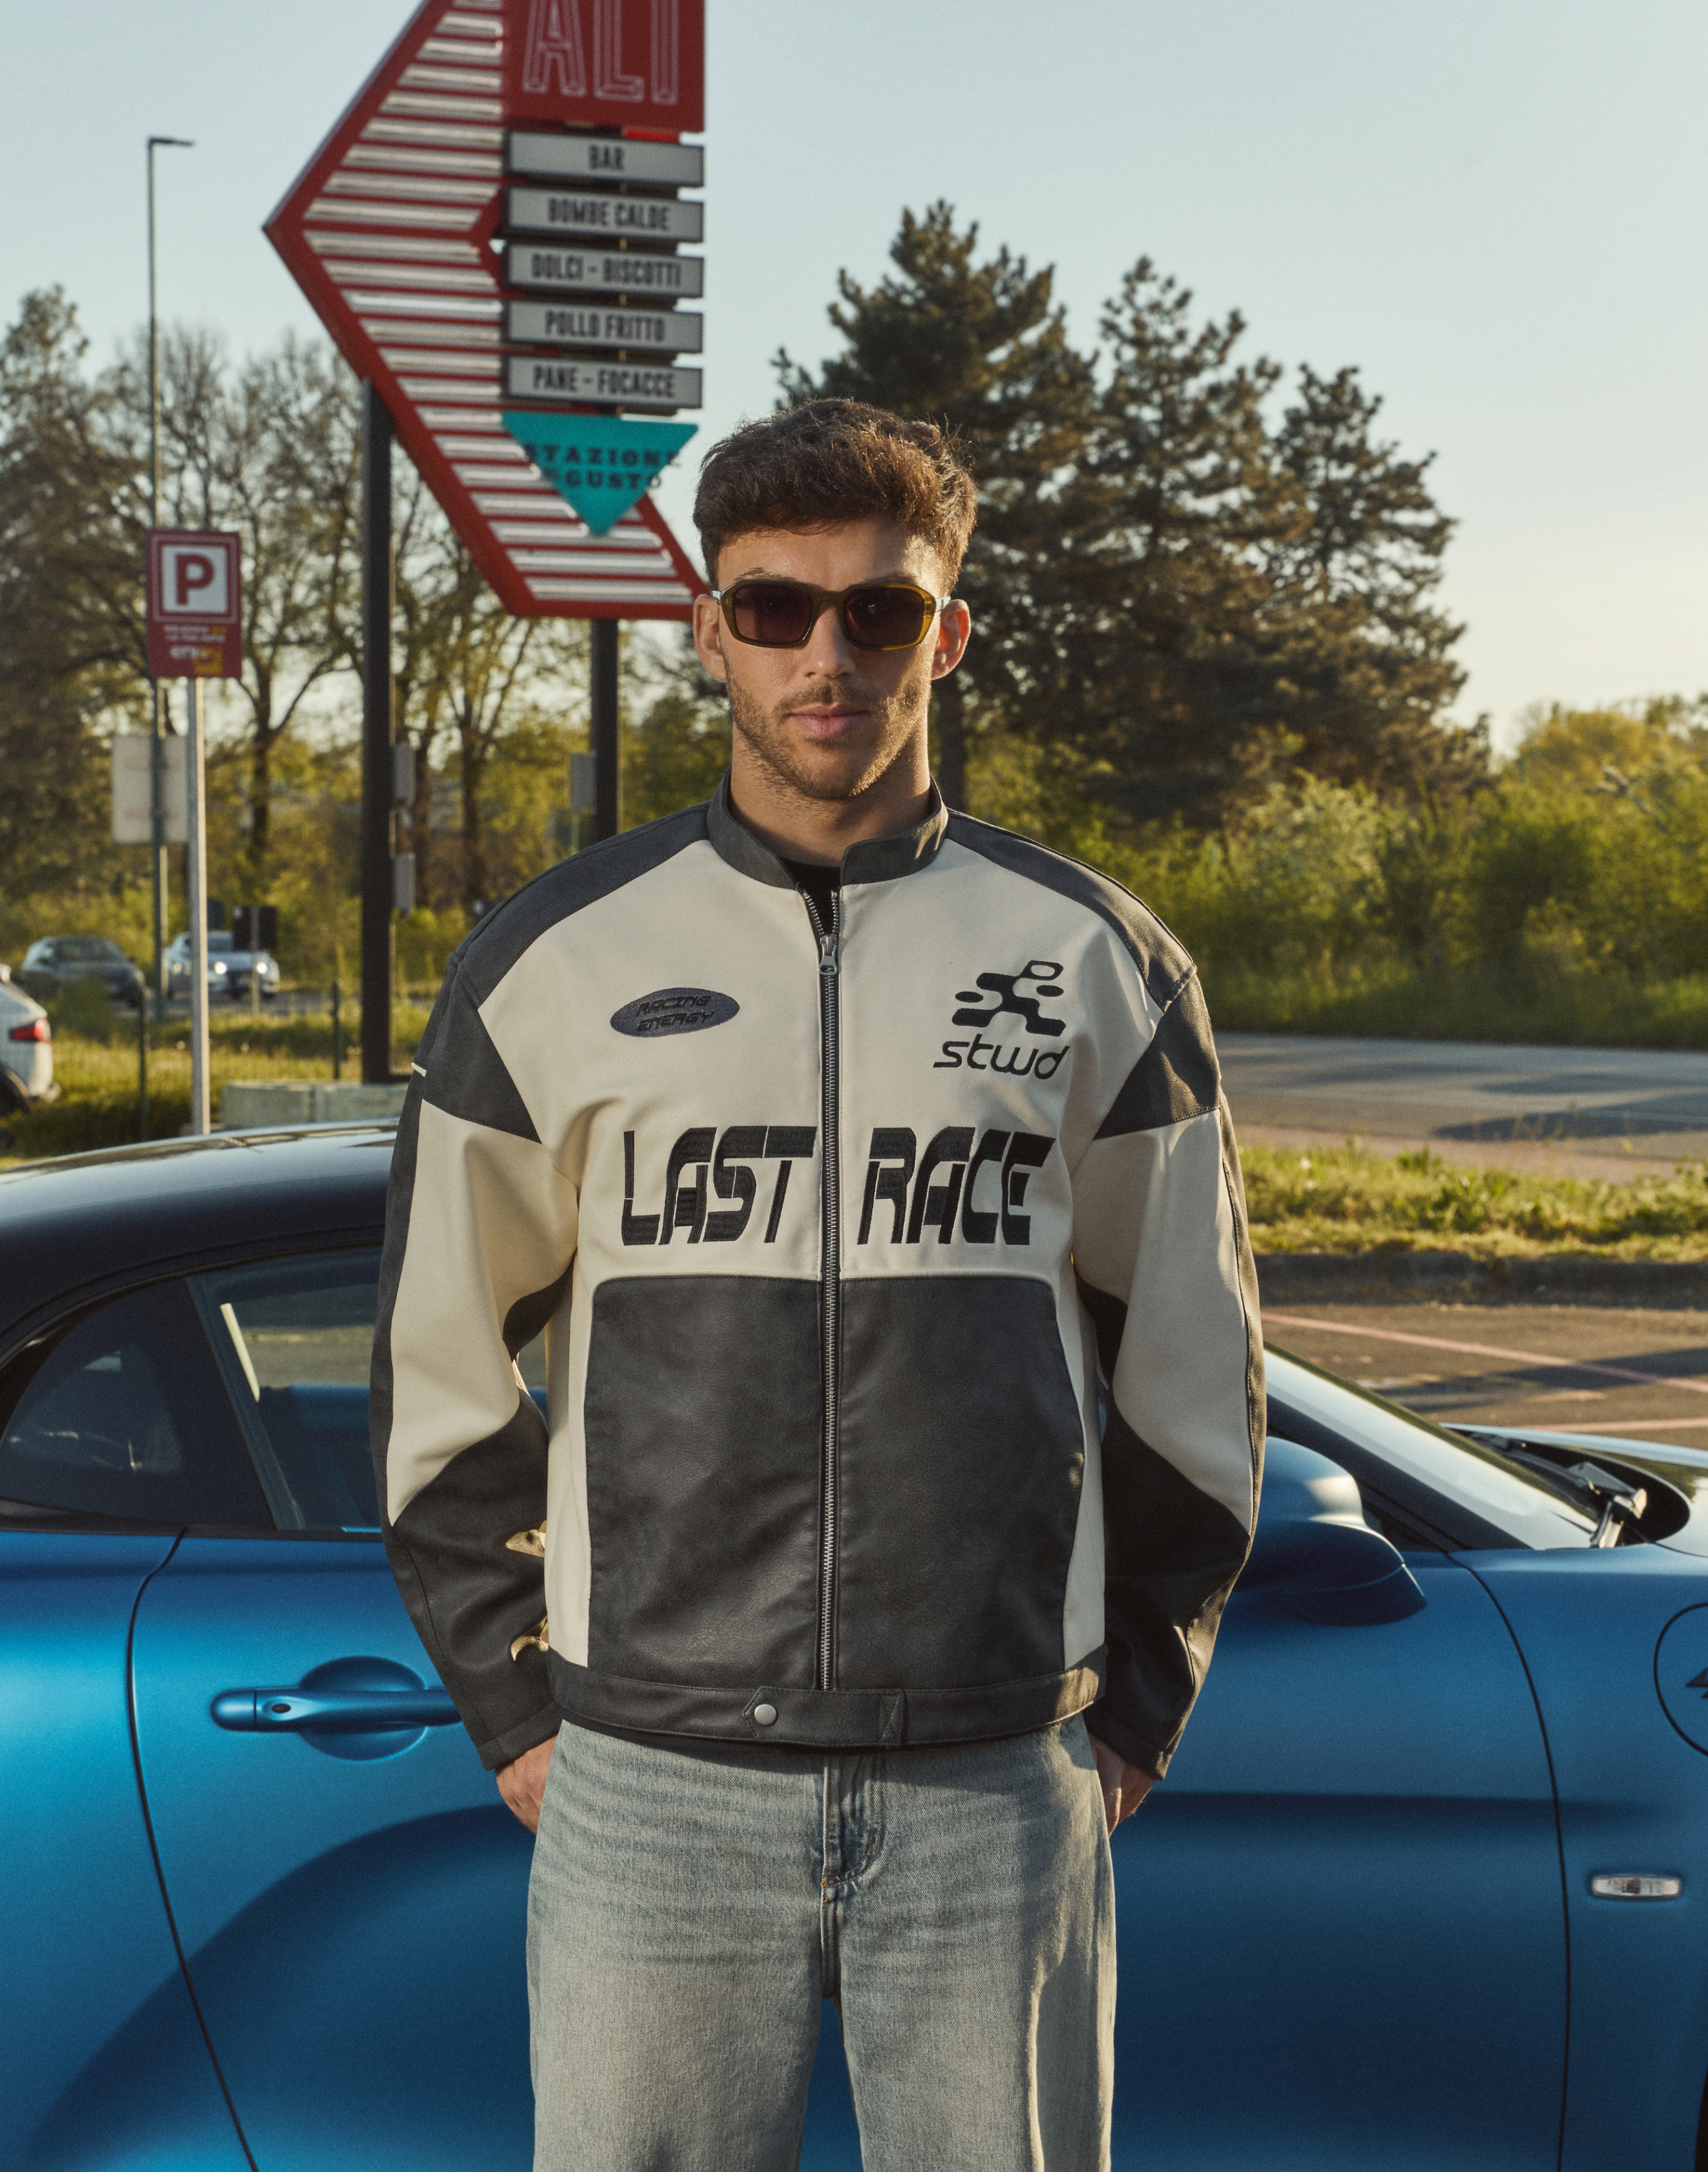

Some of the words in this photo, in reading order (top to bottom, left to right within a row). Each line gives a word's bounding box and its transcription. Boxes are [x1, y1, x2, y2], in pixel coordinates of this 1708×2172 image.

[522, 0, 678, 105] ALI
[589, 145, 624, 170] BAR
[548, 198, 609, 227] BOMBE
[615, 201, 670, 231] CALDE
[532, 253, 583, 281] DOLCI
[602, 257, 681, 287] BISCOTTI
[545, 310, 599, 338] POLLO
[605, 313, 665, 342] FRITTO
[533, 365, 577, 392] PANE
[597, 367, 675, 398] FOCACCE
[176, 554, 215, 606] P
[636, 995, 712, 1016] RACING
[636, 1010, 715, 1031] ENERGY
[933, 1033, 1070, 1079] stwd
[621, 1125, 817, 1246] LAST
[857, 1126, 1056, 1246] RACE
